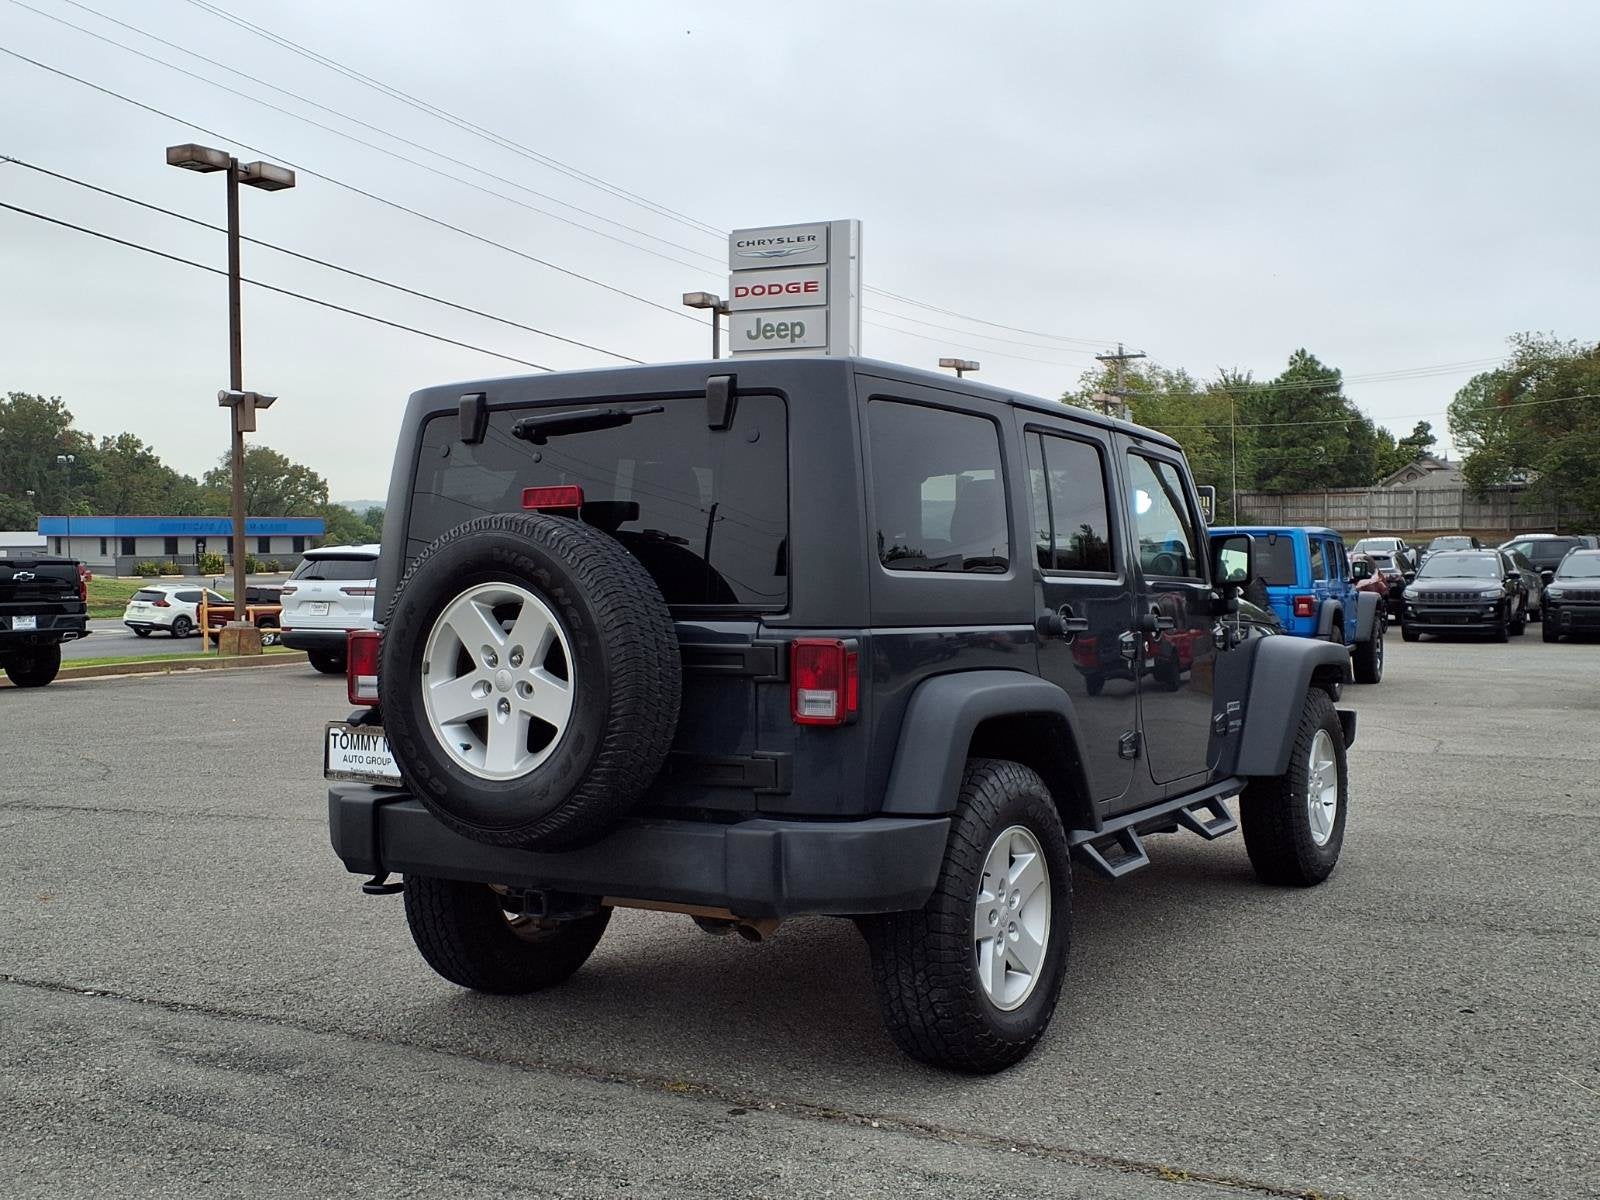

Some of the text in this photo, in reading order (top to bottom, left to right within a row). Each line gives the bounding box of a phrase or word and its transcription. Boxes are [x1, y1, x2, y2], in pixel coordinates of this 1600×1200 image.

[736, 234, 817, 248] CHRYSLER
[734, 281, 820, 298] DODGE
[746, 317, 806, 343] Jeep
[331, 732, 380, 752] TOMMY
[342, 754, 392, 766] AUTO GROUP
